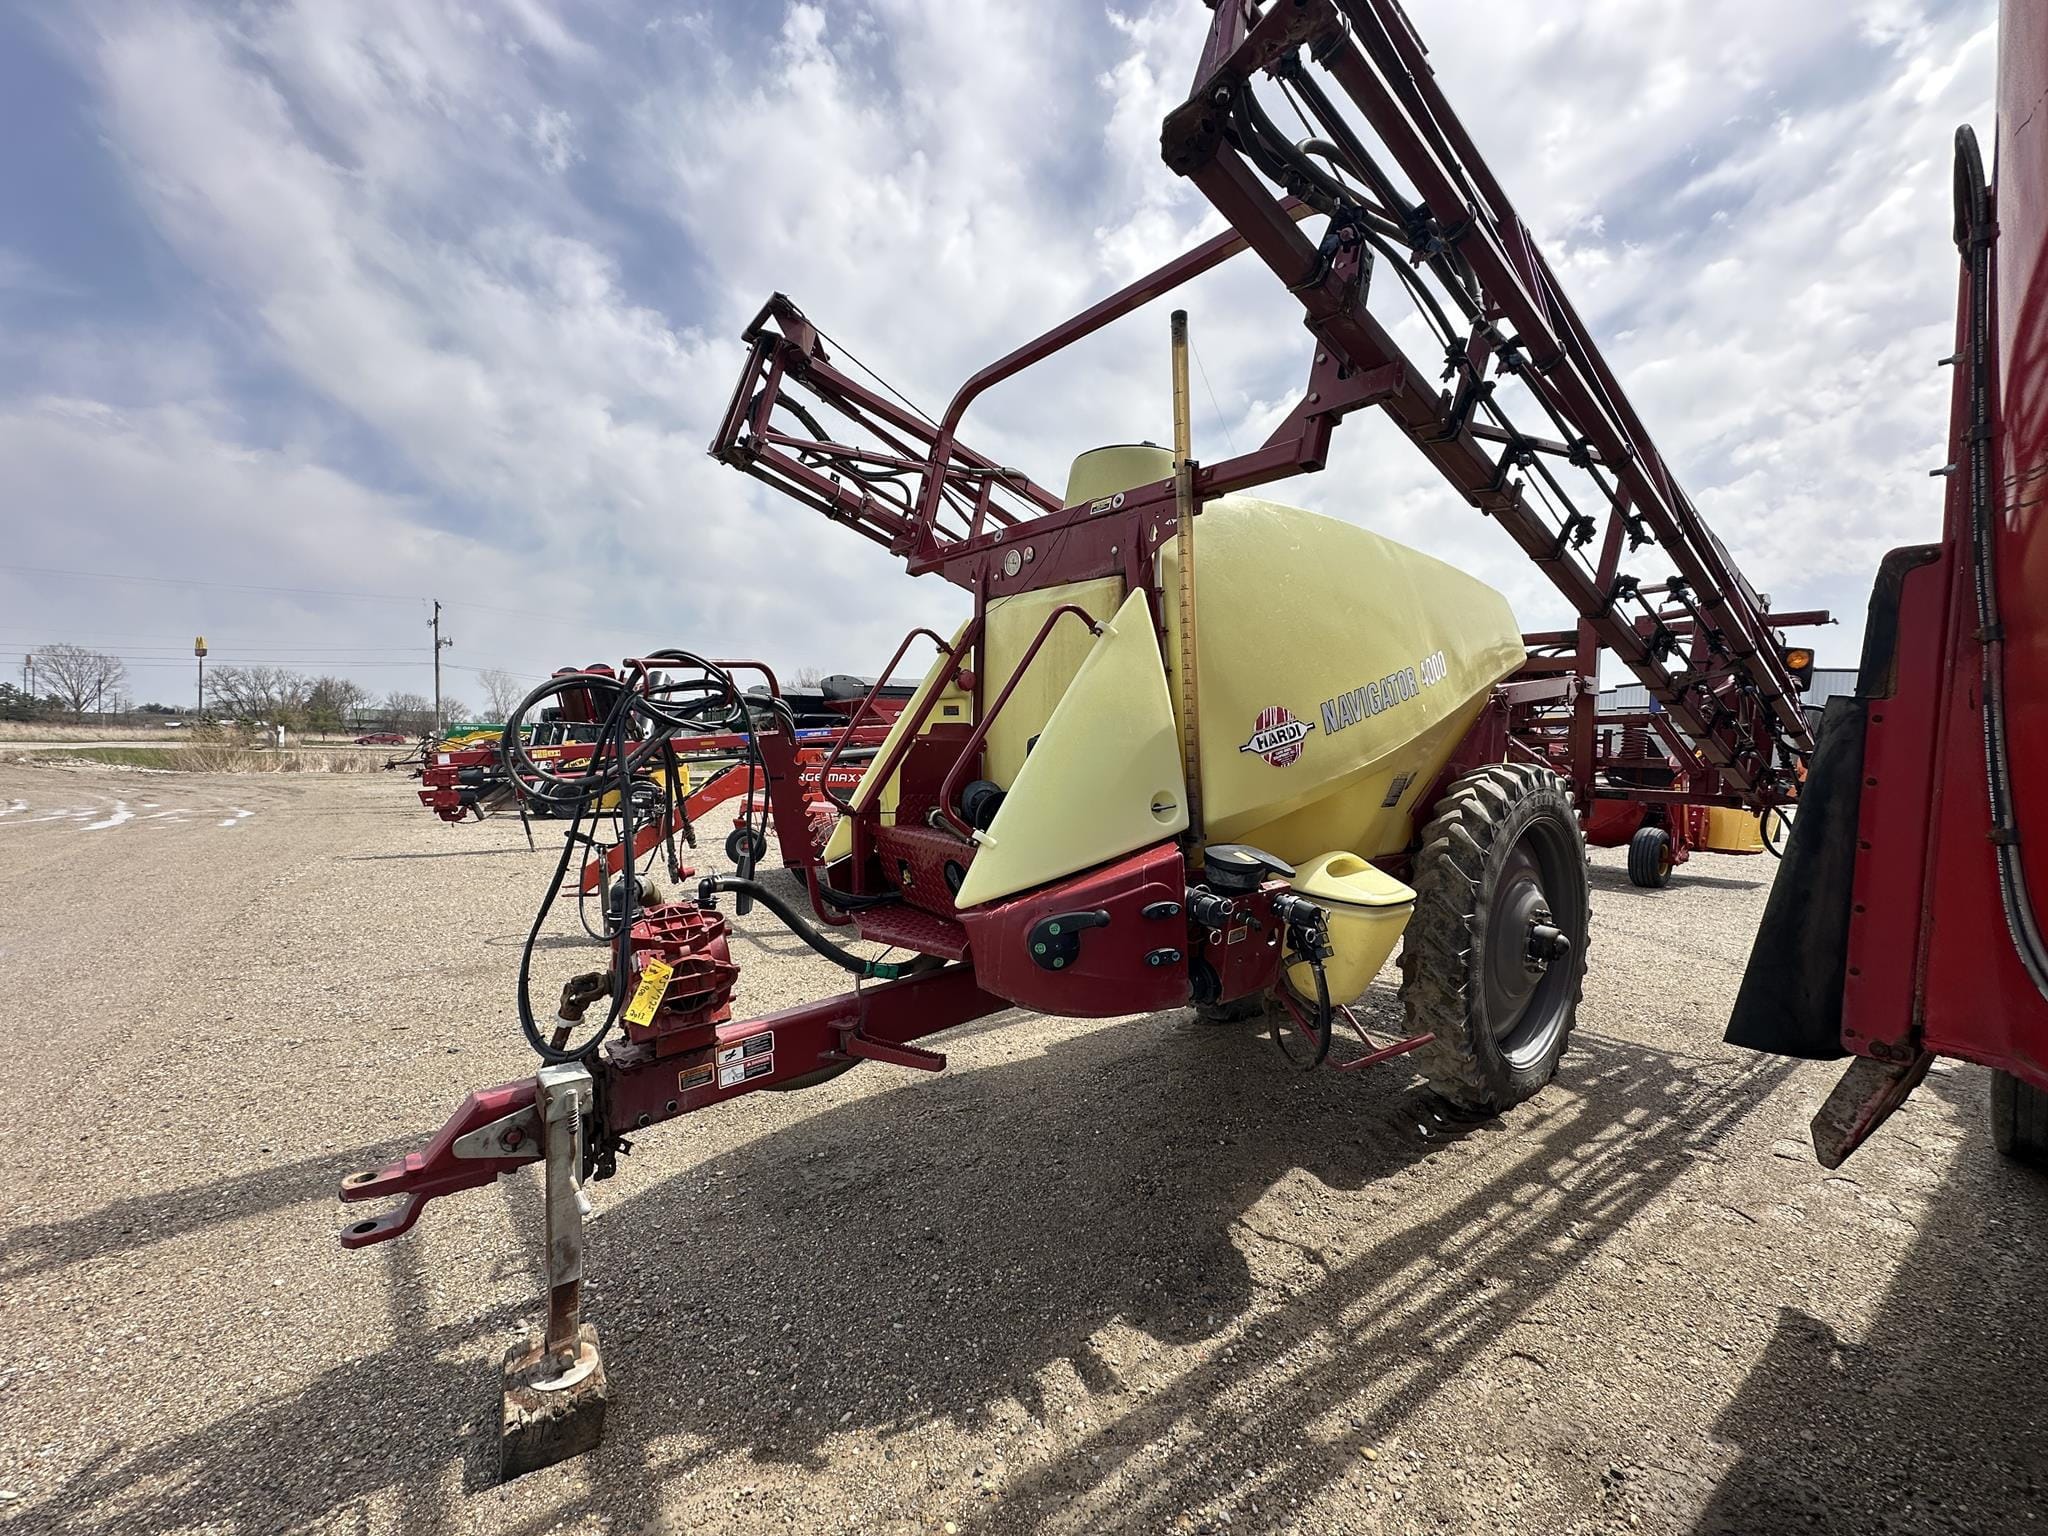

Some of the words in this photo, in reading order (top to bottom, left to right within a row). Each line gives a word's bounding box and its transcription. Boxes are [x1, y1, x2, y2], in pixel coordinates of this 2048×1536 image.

[1320, 666, 1420, 736] NAVIGATOR
[1420, 649, 1447, 687] 4000
[1256, 723, 1301, 750] HARDI
